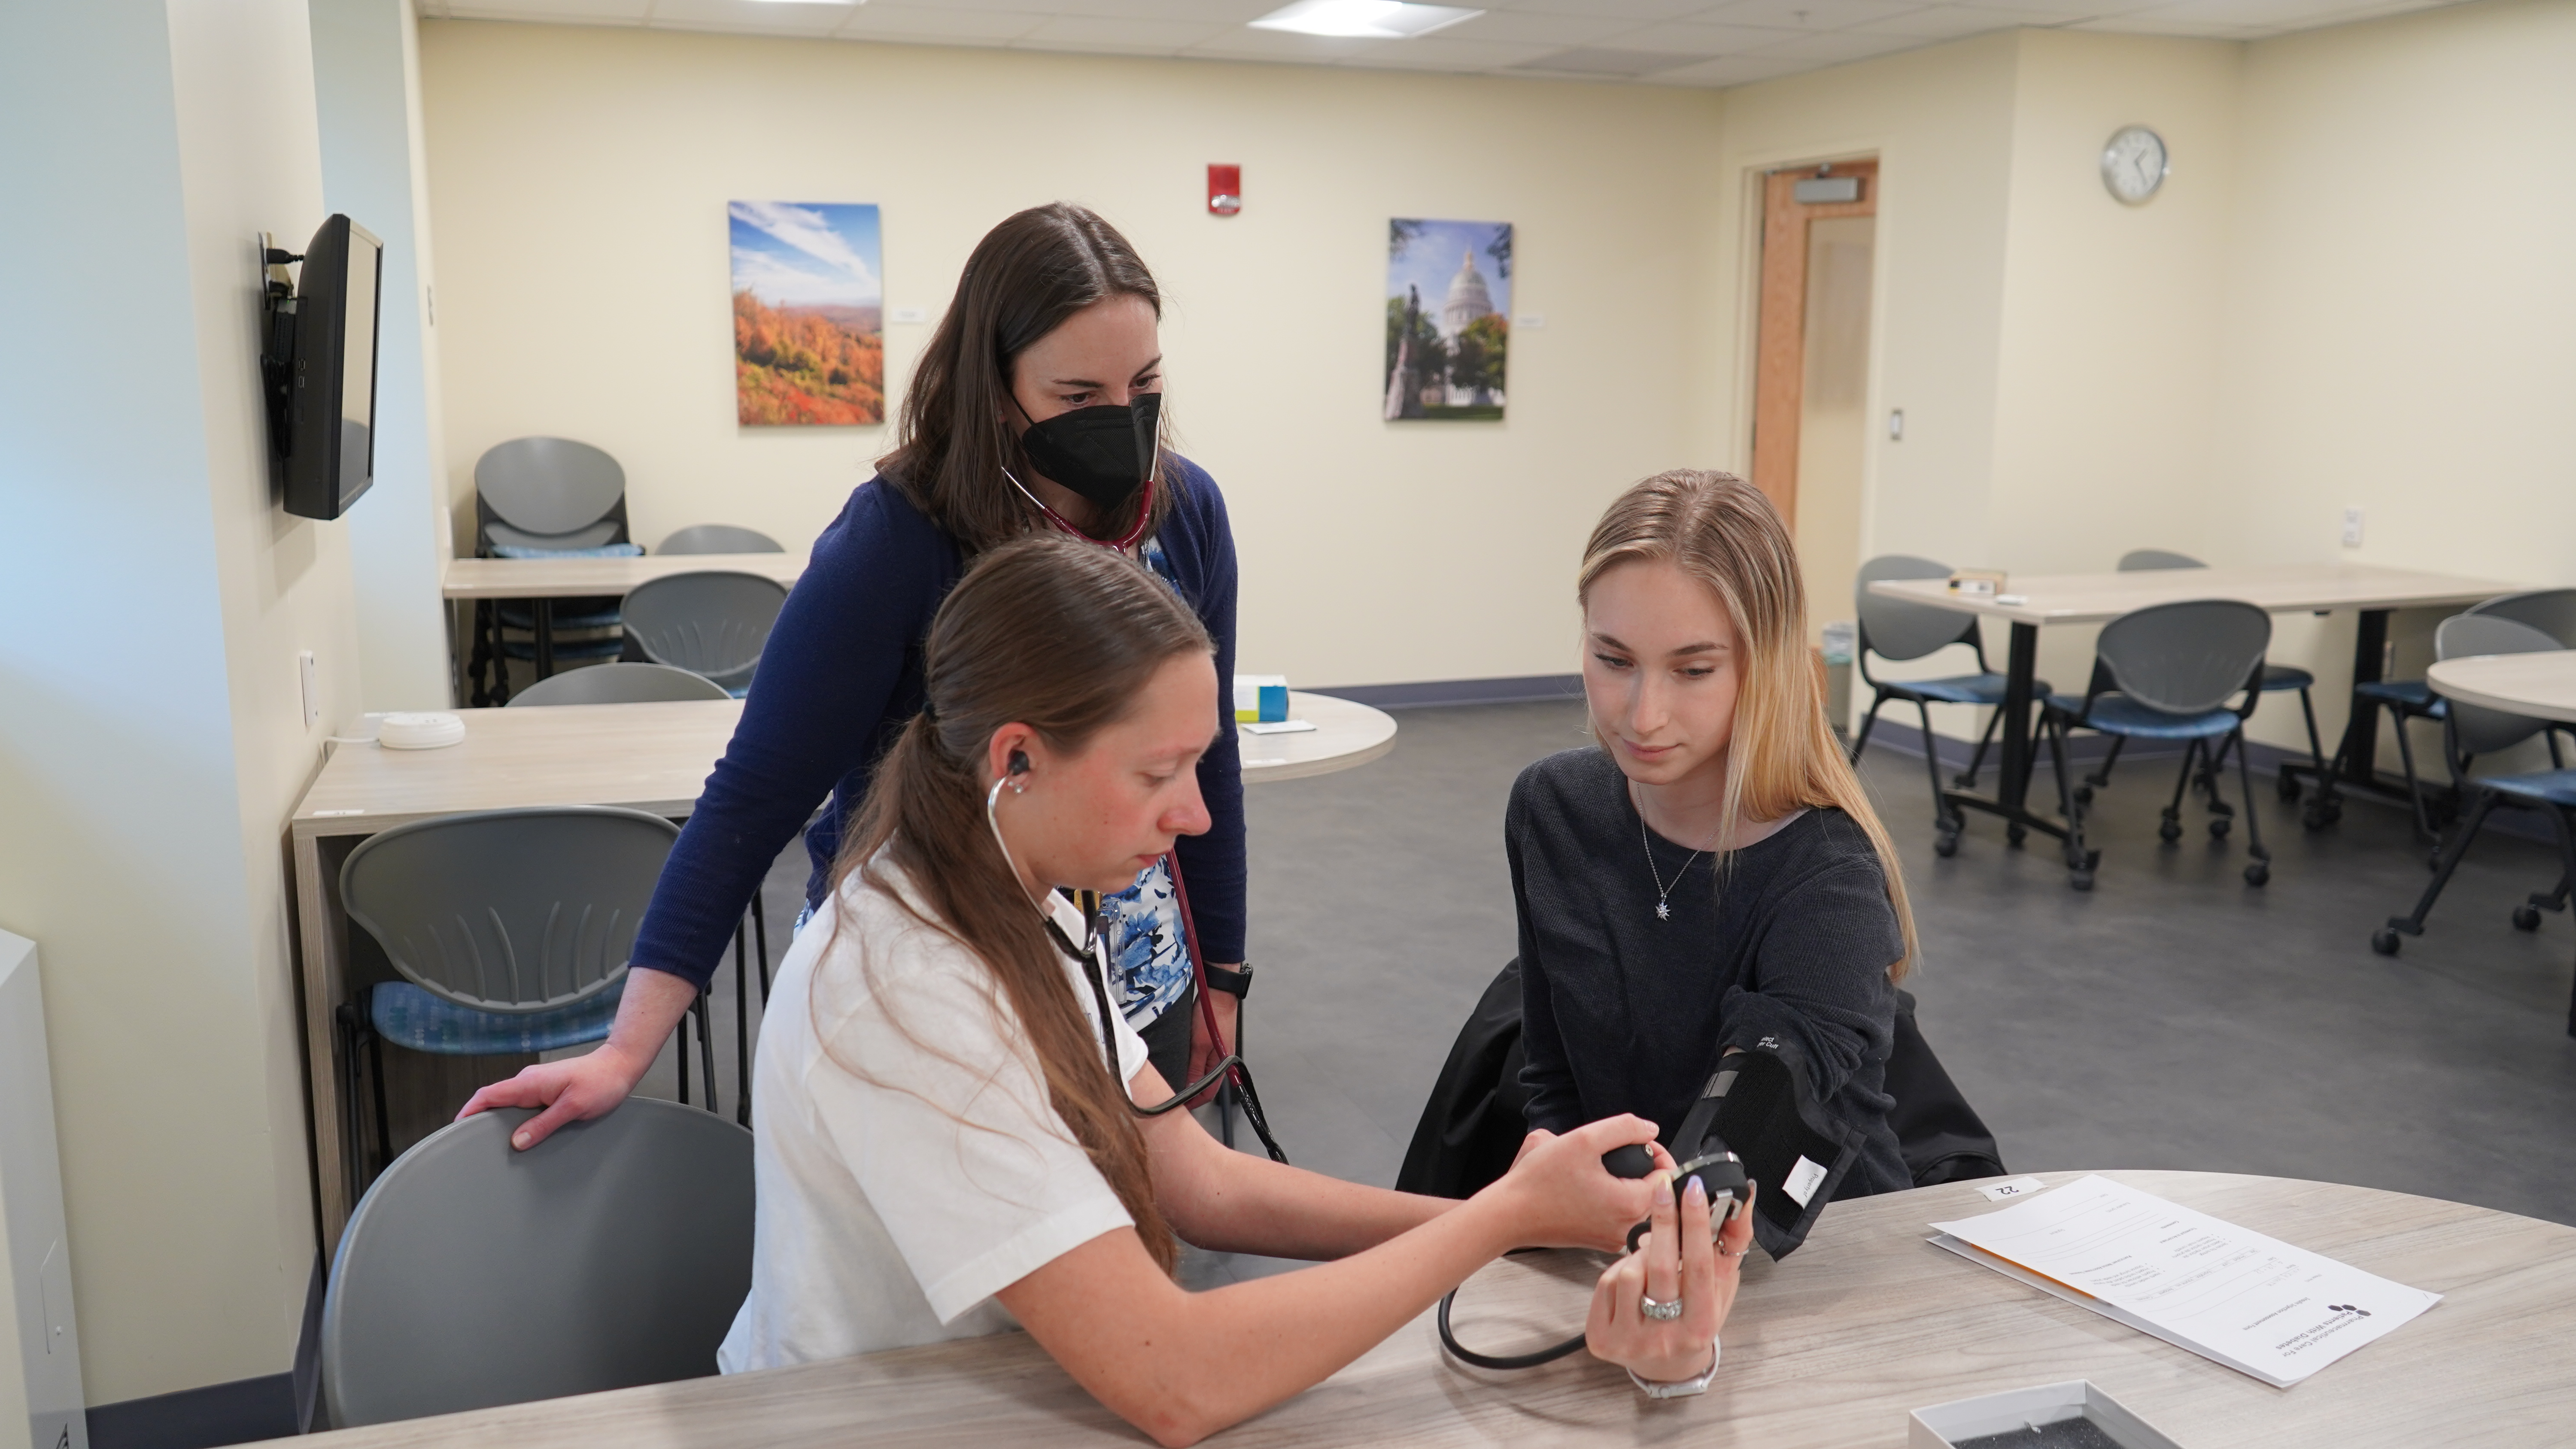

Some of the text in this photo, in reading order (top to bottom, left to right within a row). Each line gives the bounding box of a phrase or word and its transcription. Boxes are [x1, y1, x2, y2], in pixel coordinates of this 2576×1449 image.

[1804, 1173, 1819, 1191] Property
[1995, 1186, 2019, 1195] 22
[2276, 1303, 2297, 1313] Injection
[2253, 1313, 2278, 1325] Assessment
[2276, 1312, 2353, 1349] Patients With Diabetes
[2310, 1316, 2364, 1342] Pharmaceutical
[2293, 1342, 2313, 1350] Care
